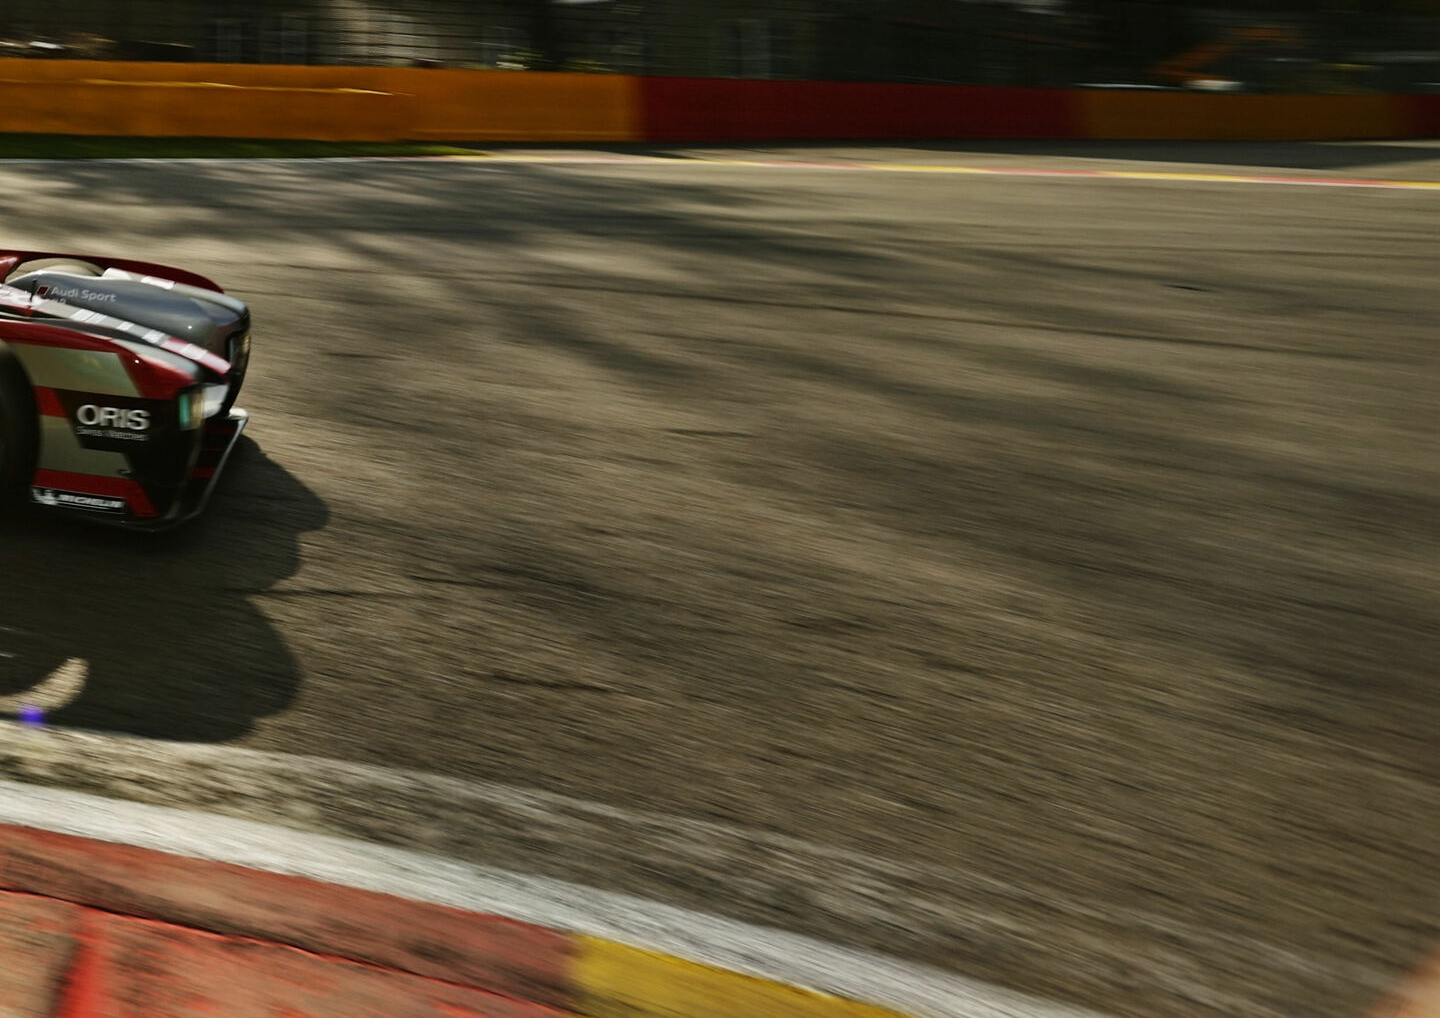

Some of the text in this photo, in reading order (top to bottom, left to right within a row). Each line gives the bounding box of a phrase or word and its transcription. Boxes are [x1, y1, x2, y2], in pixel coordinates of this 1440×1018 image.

[51, 286, 79, 298] Audi
[81, 289, 117, 303] Sport
[77, 404, 151, 430] ORIS
